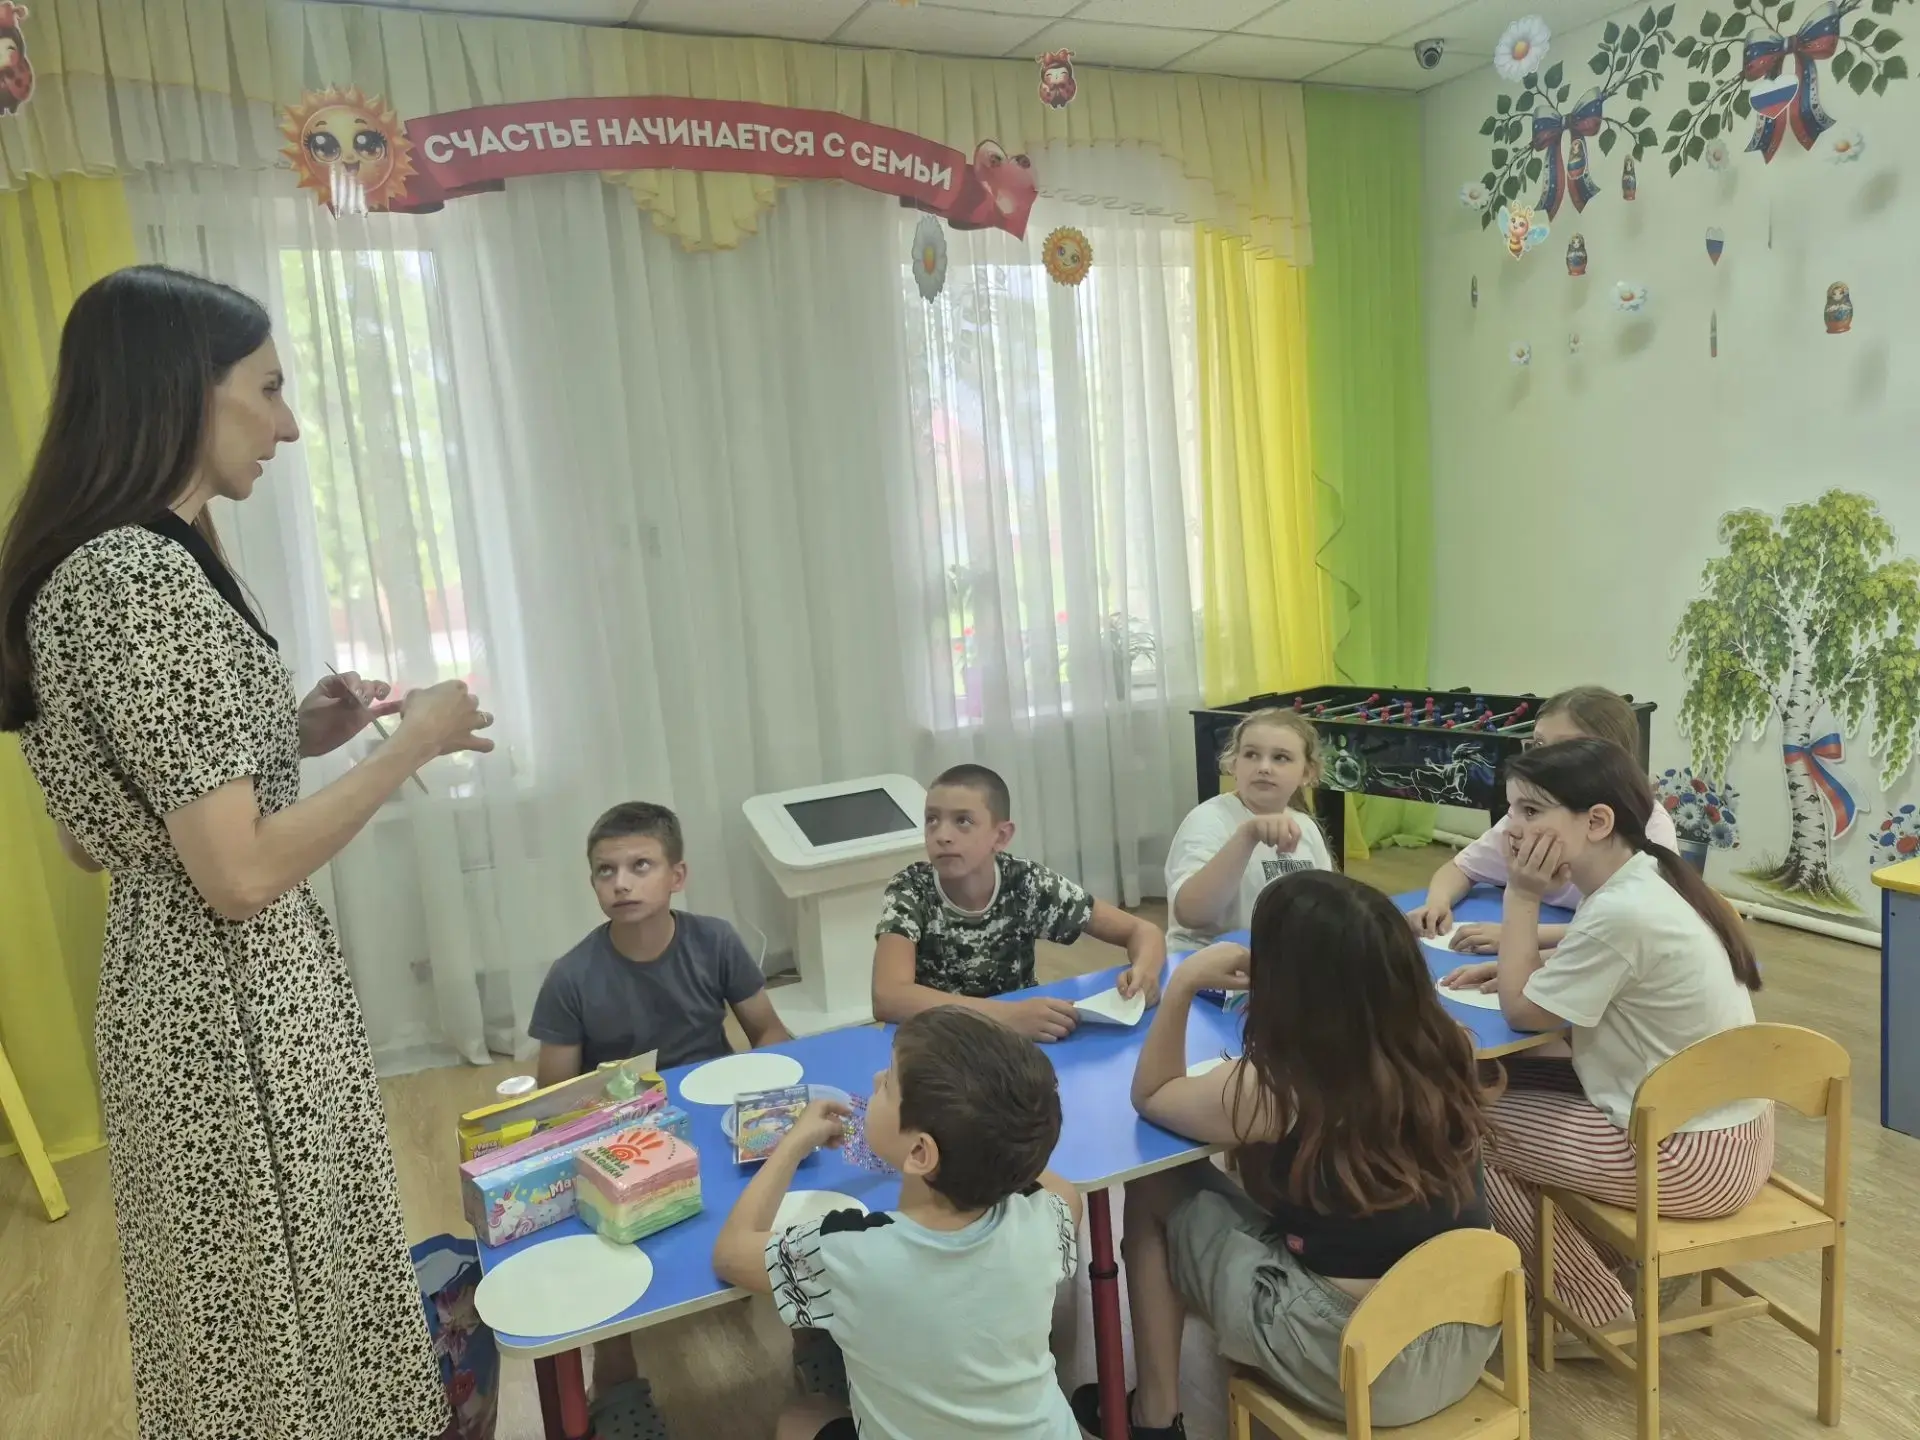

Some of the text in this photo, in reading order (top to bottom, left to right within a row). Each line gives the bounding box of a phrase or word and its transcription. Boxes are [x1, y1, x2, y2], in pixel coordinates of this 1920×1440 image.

[424, 117, 952, 191] СЧАСТЬЕ НАЧИНАЕТСЯ С СЕМЬИ
